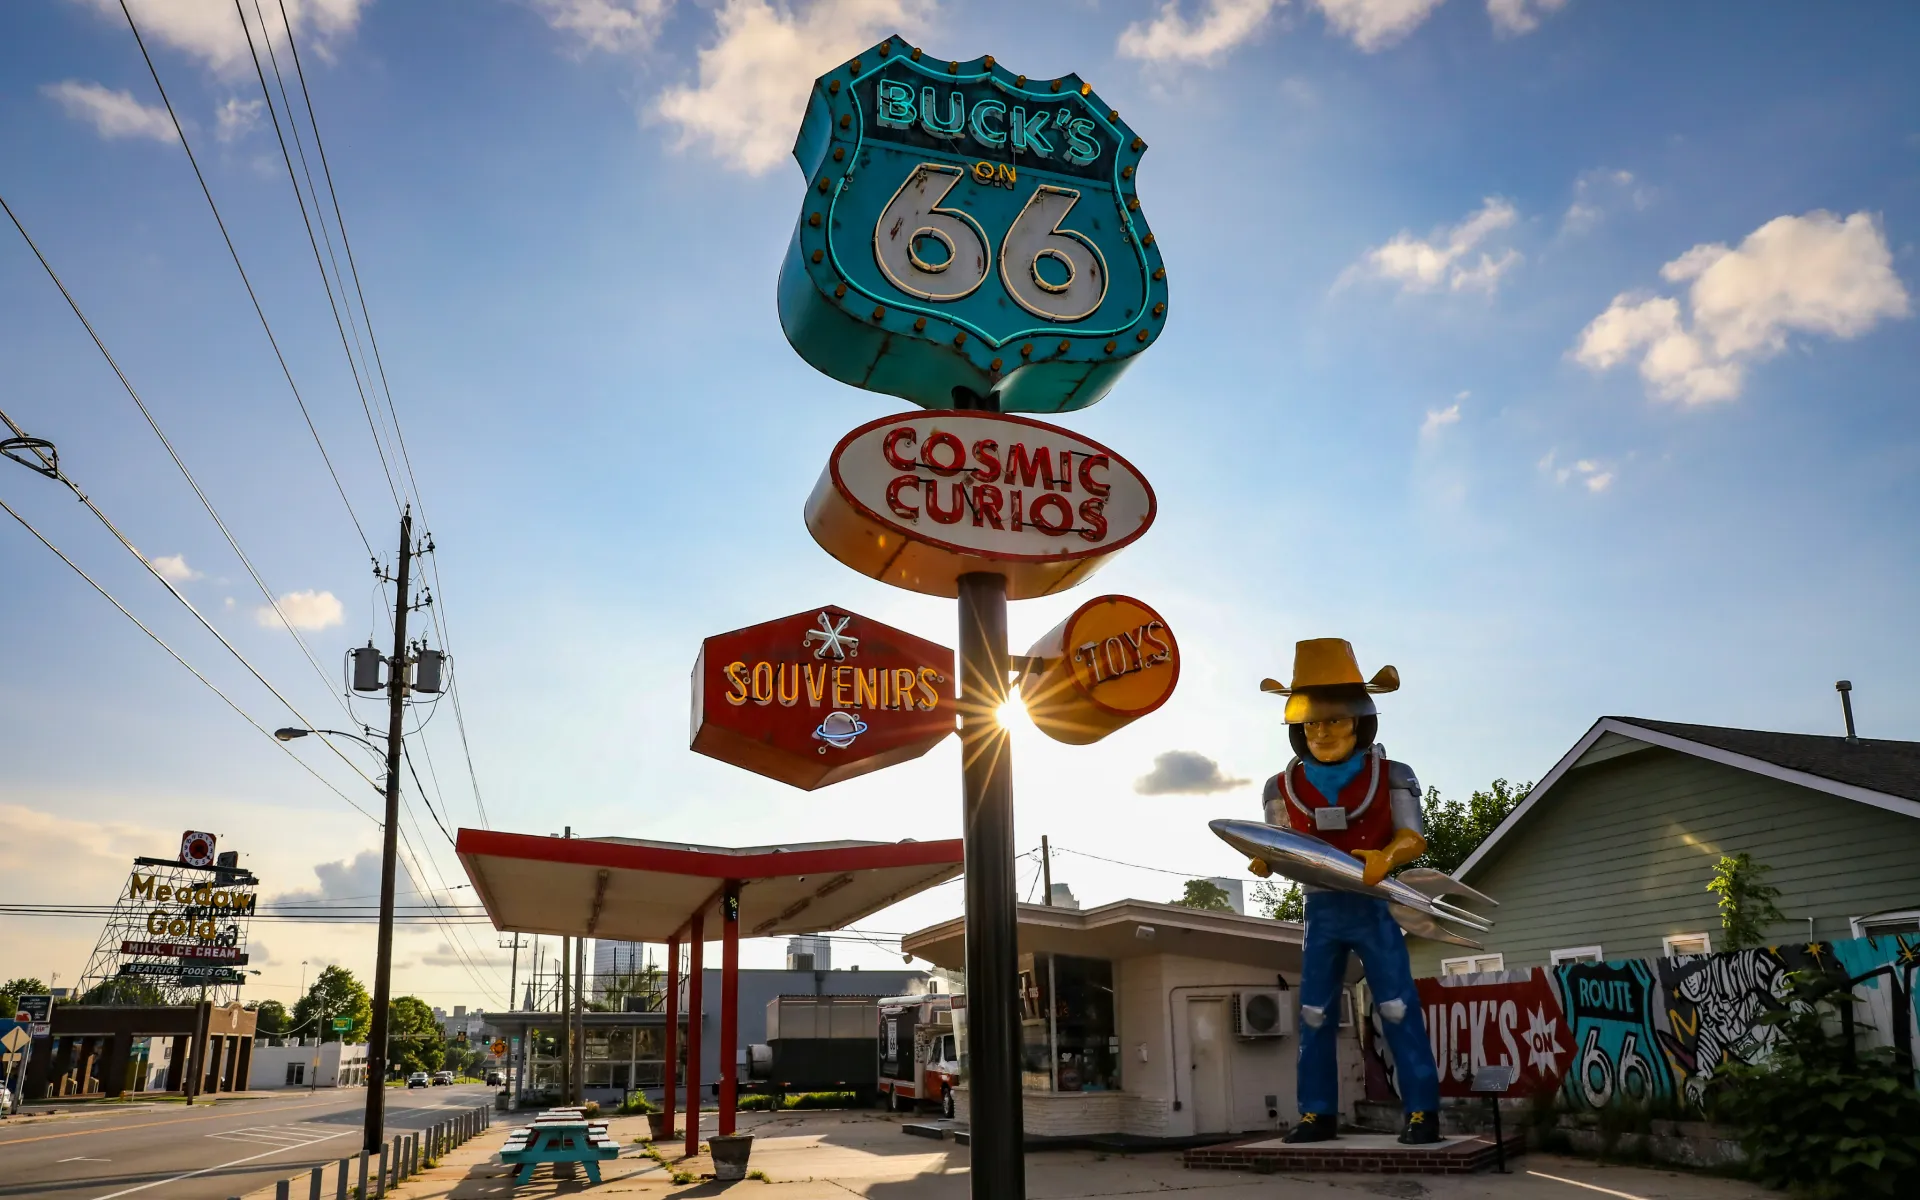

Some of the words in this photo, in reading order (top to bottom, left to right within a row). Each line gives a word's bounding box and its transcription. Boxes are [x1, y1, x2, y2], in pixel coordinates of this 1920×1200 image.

[876, 78, 1101, 167] BUCK'S
[972, 160, 1018, 191] ON
[874, 162, 1109, 322] 66
[882, 426, 1110, 498] COSMIC
[885, 474, 1109, 543] CURIOS
[1077, 620, 1171, 683] TOYS
[723, 660, 942, 712] SOUVENIRS
[129, 872, 251, 910] Meadow
[147, 909, 217, 940] Gold
[128, 964, 180, 975] BEATRICE
[214, 968, 229, 977] CO.
[171, 945, 192, 957] ICE
[195, 947, 236, 959] CREAM
[1578, 977, 1635, 1013] ROUTE
[1423, 999, 1521, 1085] UCK'S
[1532, 1028, 1553, 1053] ON
[1580, 1026, 1654, 1108] 66
